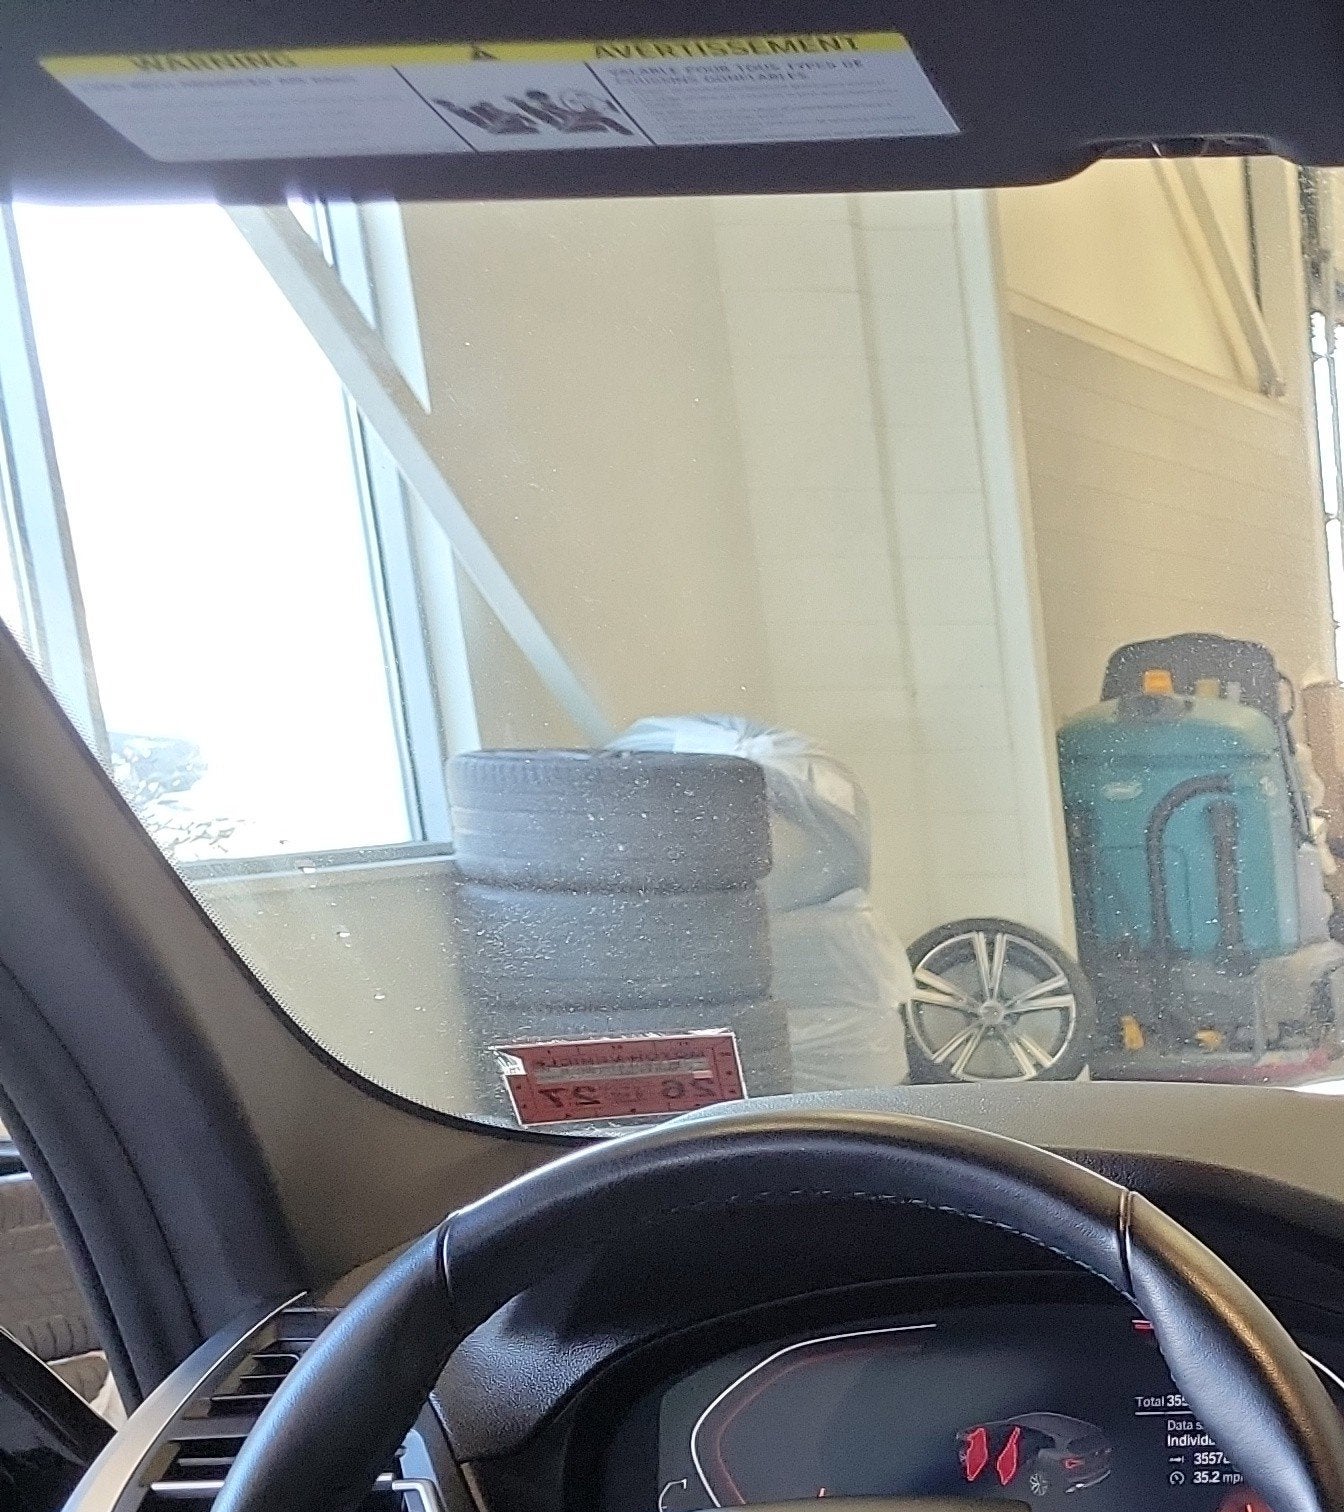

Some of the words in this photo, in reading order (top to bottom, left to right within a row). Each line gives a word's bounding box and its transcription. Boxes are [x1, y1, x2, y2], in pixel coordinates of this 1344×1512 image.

[594, 33, 860, 60] AVERTISSEMENT
[1134, 1396, 1165, 1407] Total
[1167, 1420, 1193, 1431] Data
[1193, 1471, 1221, 1484] 35.2
